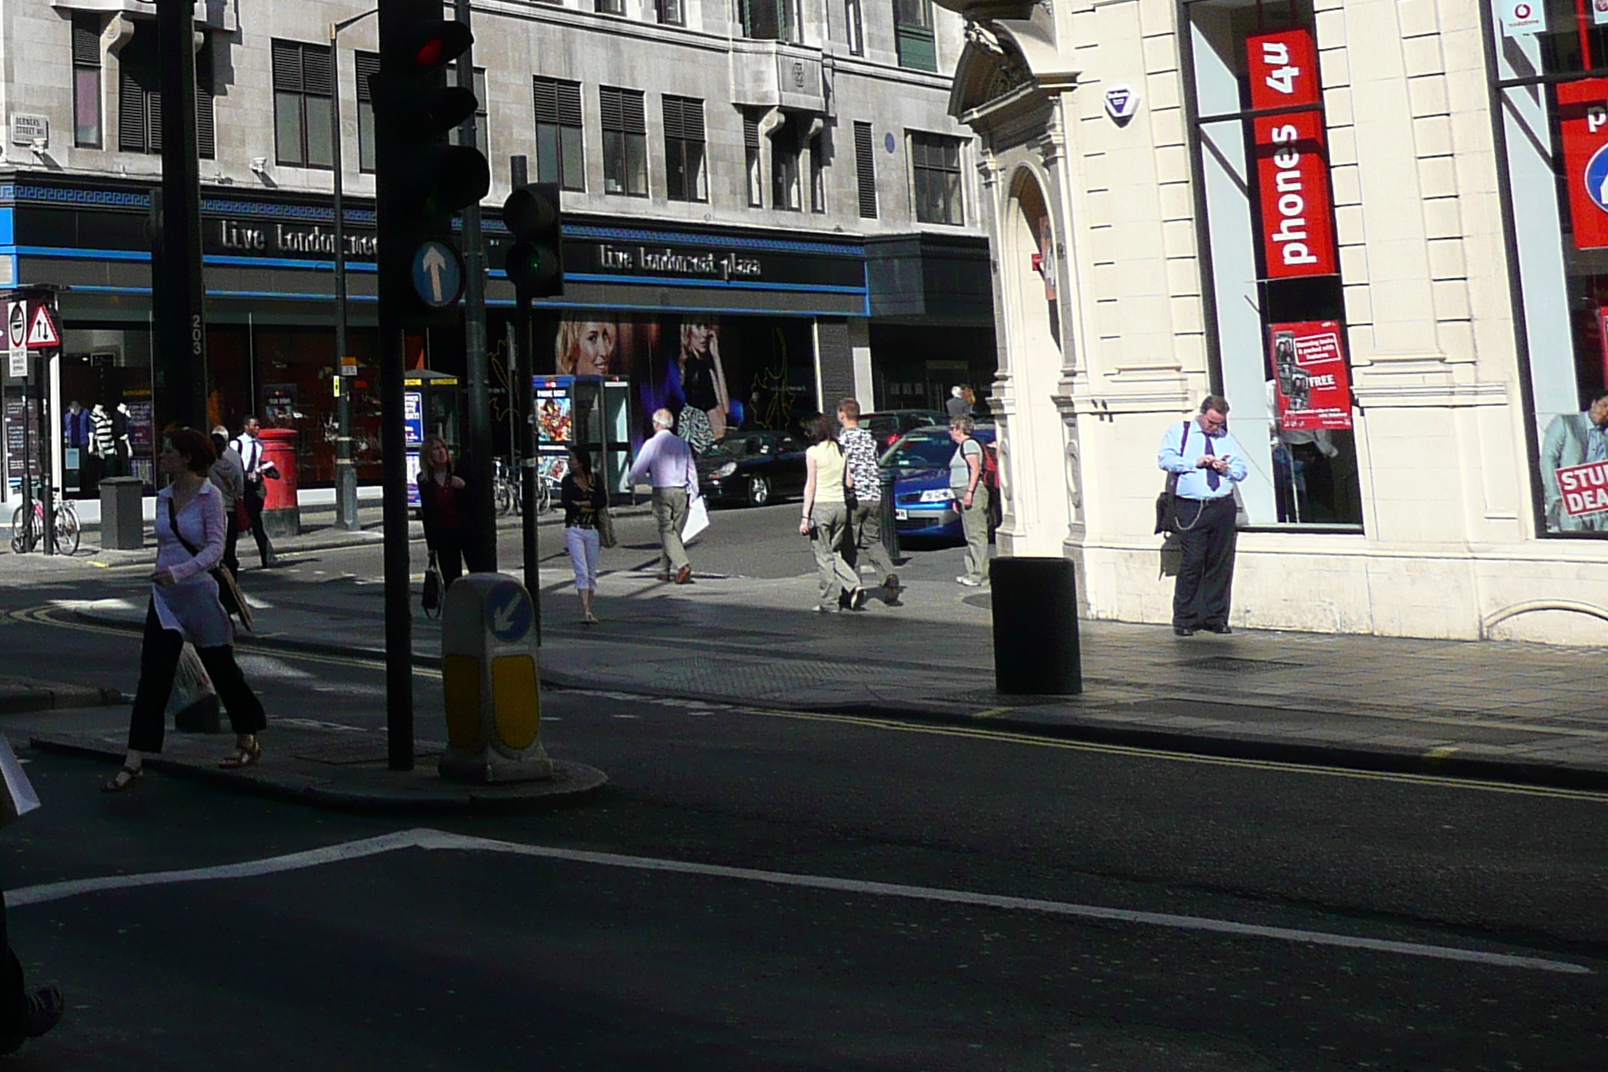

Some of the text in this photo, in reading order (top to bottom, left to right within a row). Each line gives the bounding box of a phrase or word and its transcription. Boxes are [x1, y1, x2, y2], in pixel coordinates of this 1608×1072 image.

[1262, 42, 1318, 266] phones 4u
[1309, 374, 1335, 387] FREE
